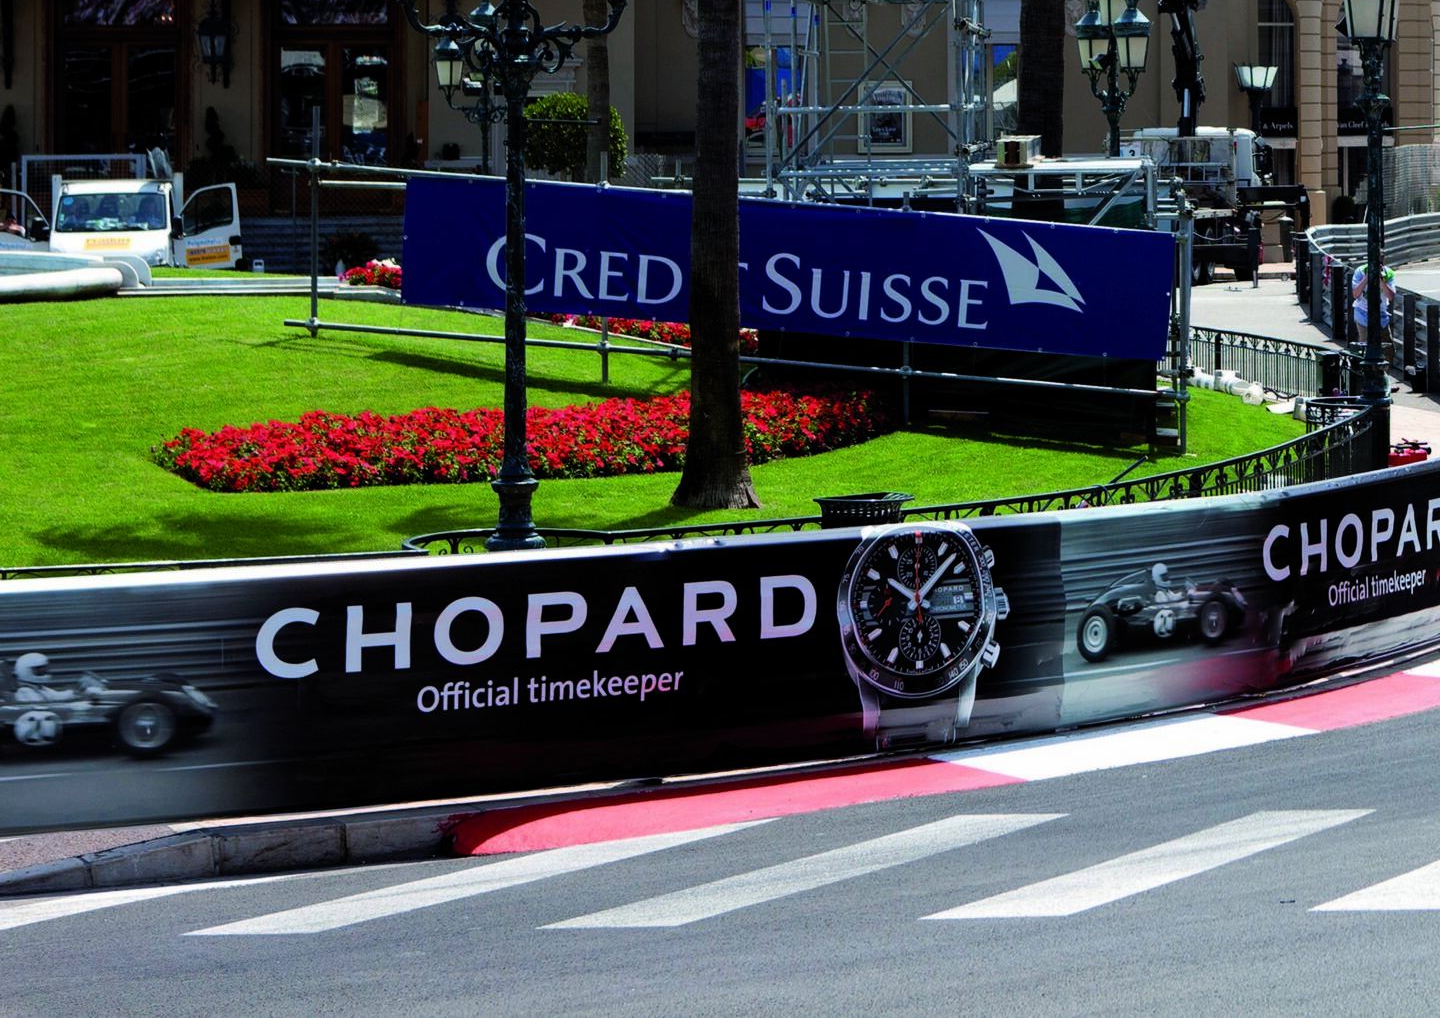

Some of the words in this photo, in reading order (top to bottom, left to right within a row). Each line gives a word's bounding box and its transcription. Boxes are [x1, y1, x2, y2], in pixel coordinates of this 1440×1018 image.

[1270, 121, 1294, 131] Arpels
[486, 233, 747, 305] CRED
[762, 252, 989, 330] SUISSE
[1328, 576, 1369, 607] Official
[1371, 569, 1427, 597] timekeeper
[255, 574, 817, 679] CHOPARD
[416, 676, 519, 713] Official
[527, 668, 684, 705] timekeeper
